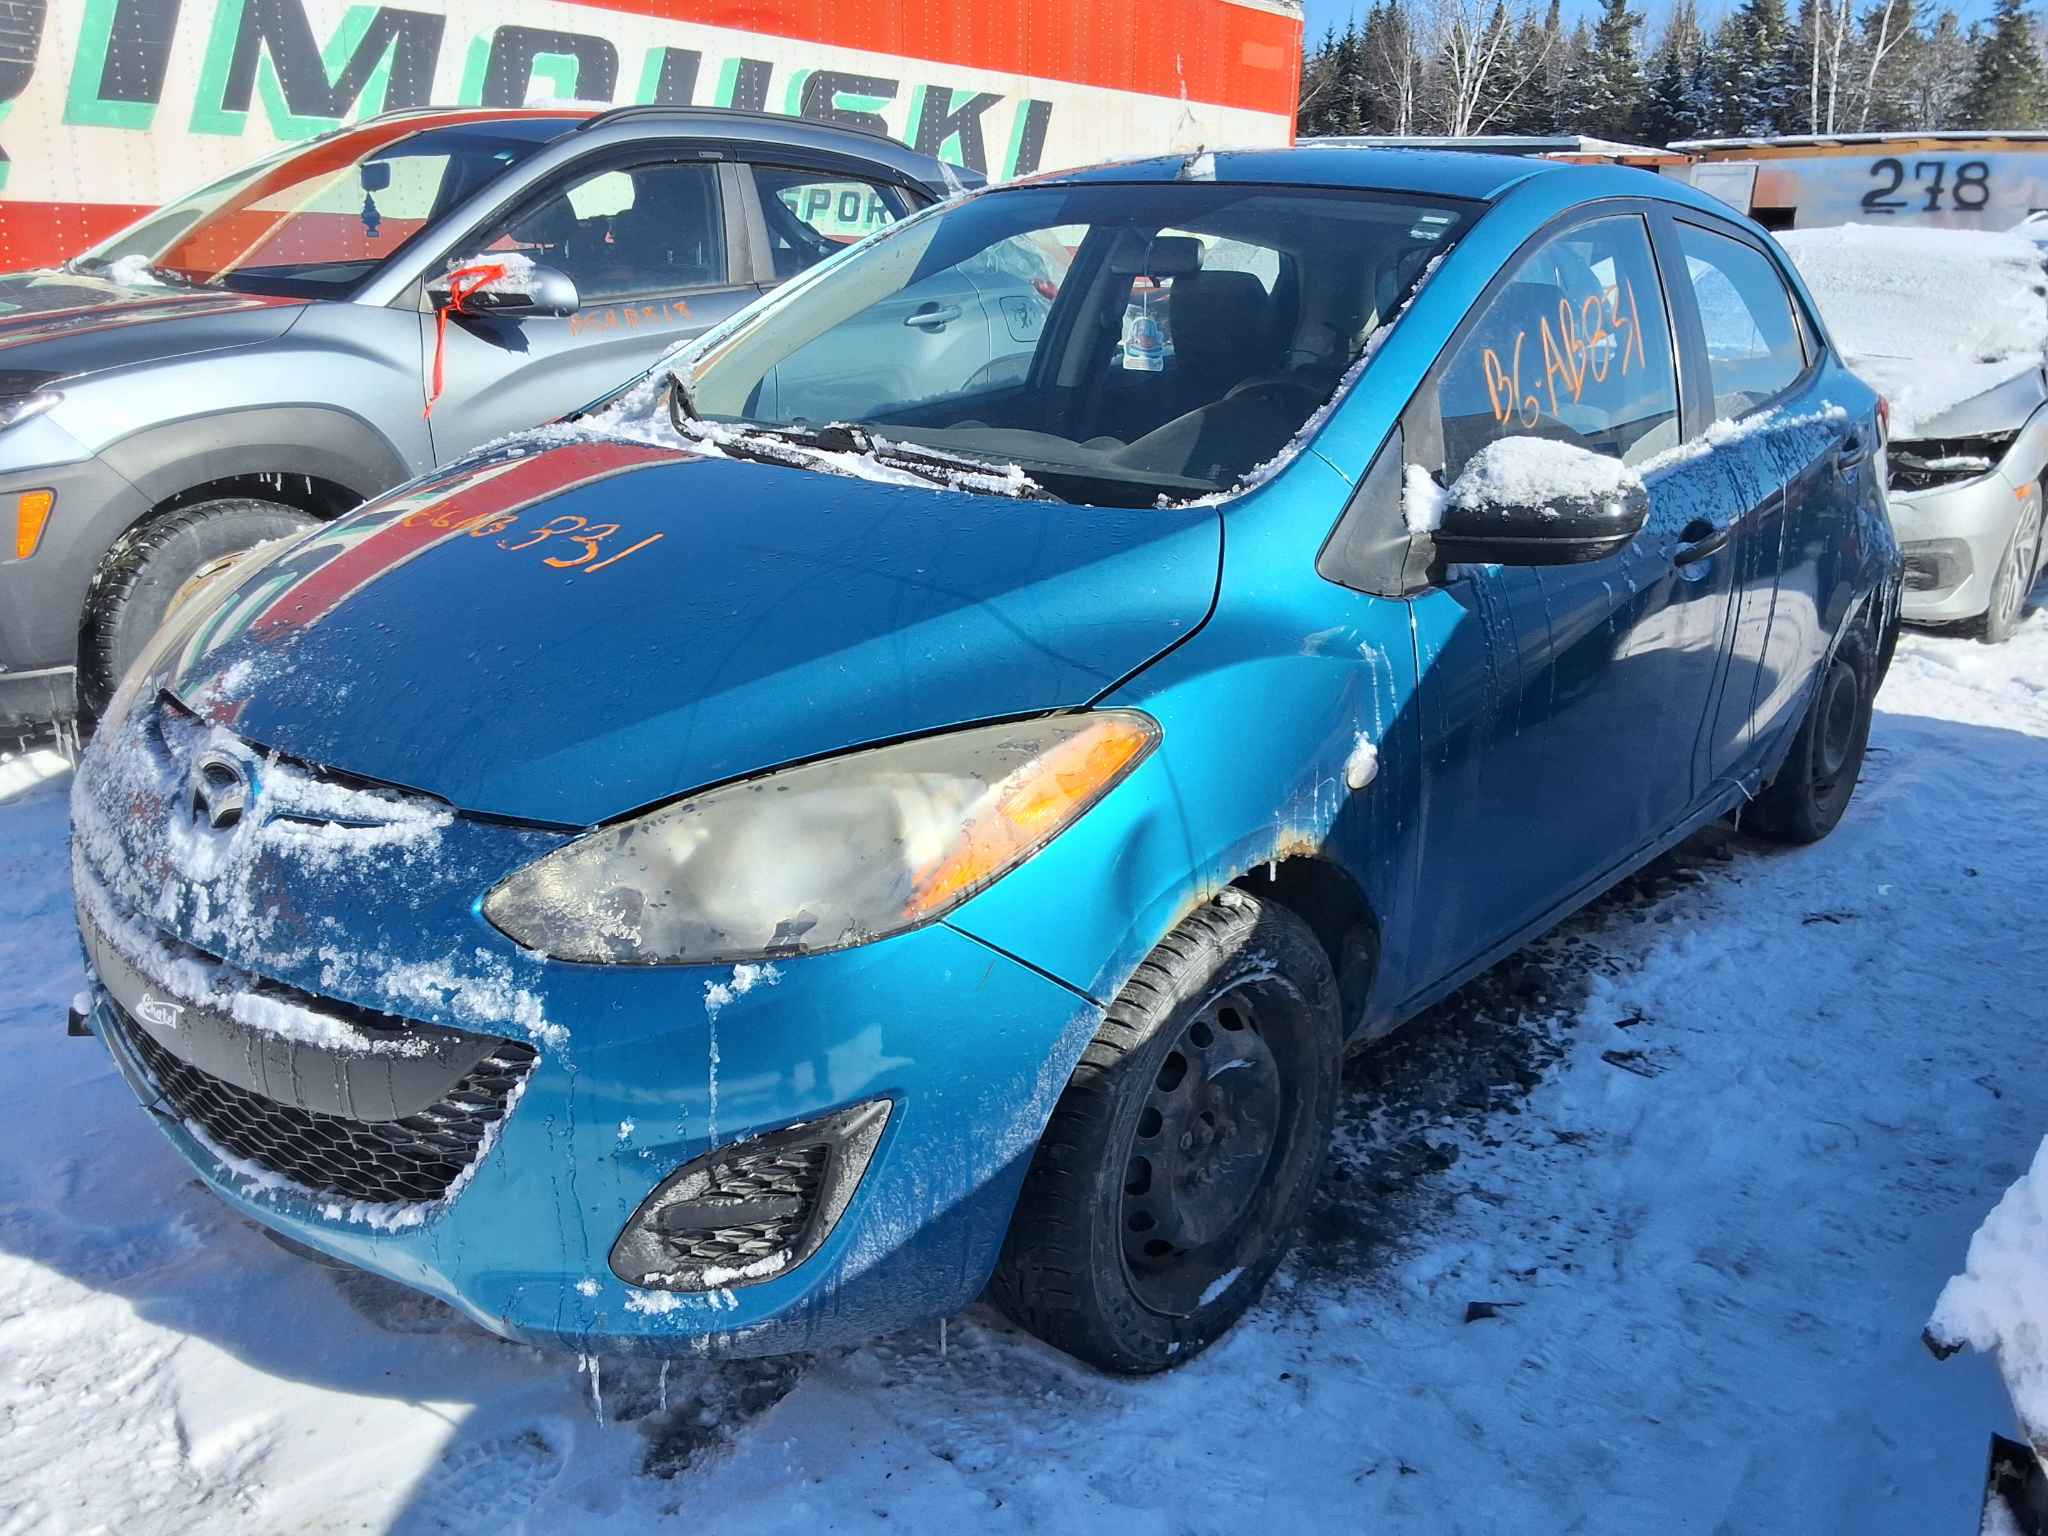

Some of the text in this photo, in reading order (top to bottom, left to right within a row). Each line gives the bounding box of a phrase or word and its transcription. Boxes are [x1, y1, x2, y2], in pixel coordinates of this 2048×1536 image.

[0, 0, 1053, 180] IMOUSKI
[783, 188, 892, 225] POR
[1861, 157, 1990, 213] 278
